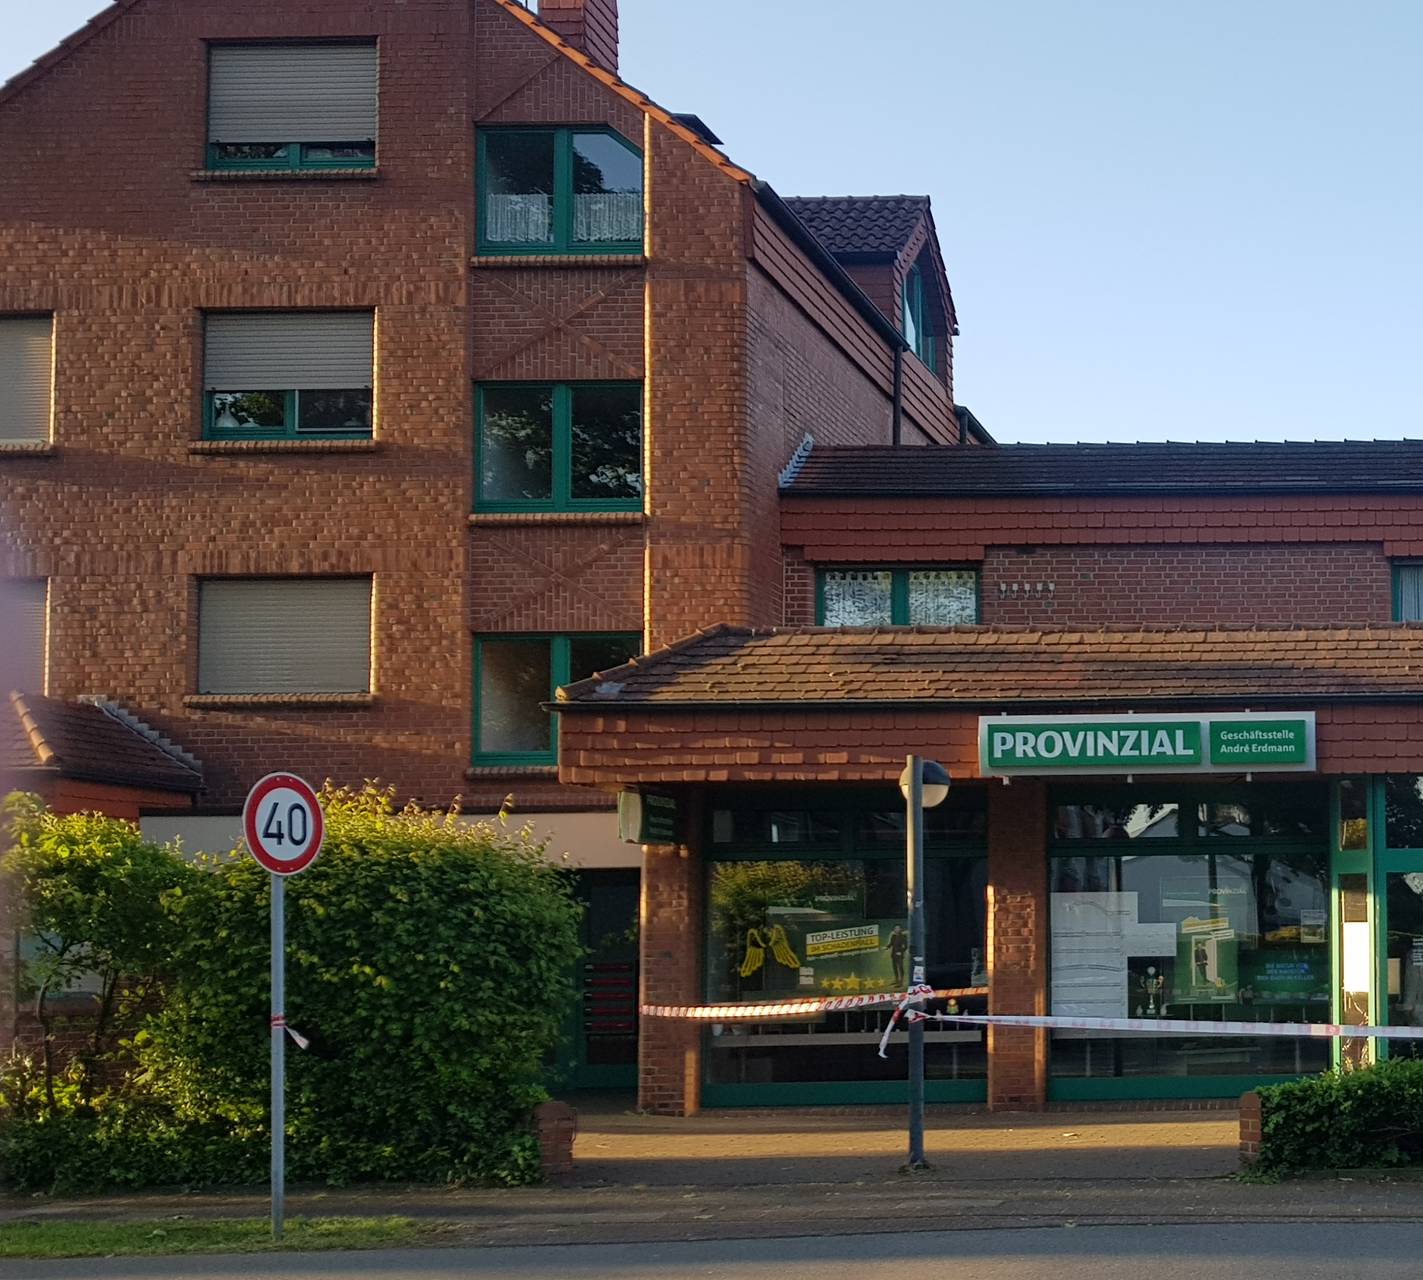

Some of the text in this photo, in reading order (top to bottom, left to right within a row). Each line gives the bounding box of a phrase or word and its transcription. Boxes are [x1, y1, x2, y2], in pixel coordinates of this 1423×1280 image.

[1220, 730, 1295, 740] Geschäftsstelle
[993, 730, 1194, 758] PROVINZIAL
[1220, 743, 1295, 753] André Erdmann
[262, 802, 307, 846] 40
[811, 927, 873, 942] TOP-LEISTUNG
